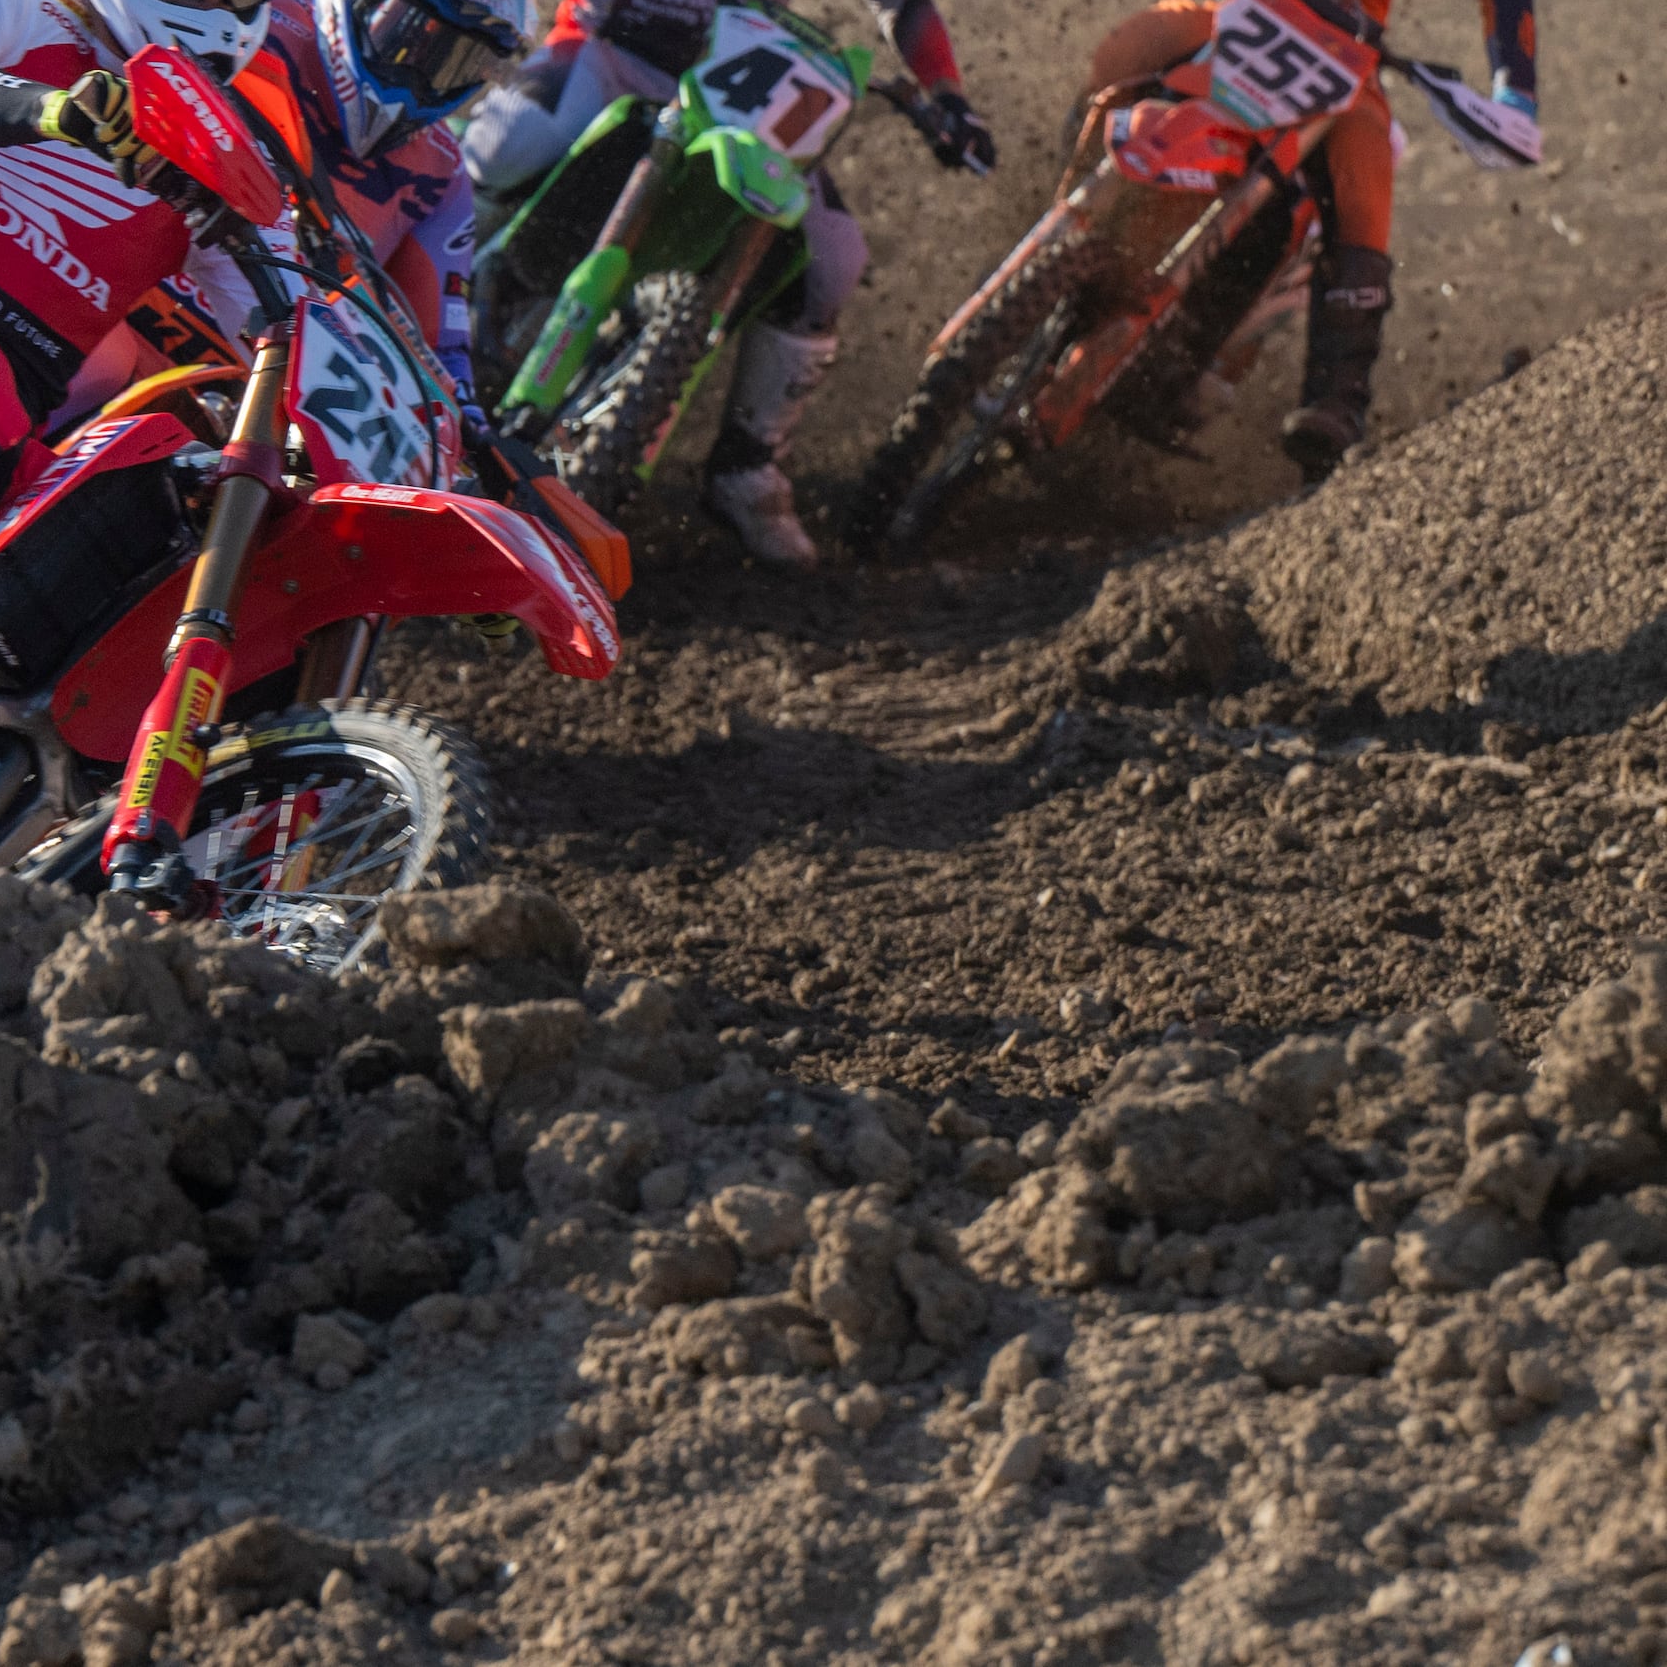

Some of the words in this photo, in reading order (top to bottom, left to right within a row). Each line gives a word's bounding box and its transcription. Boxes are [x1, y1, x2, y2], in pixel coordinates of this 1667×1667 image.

[703, 46, 835, 151] 41
[1215, 7, 1353, 117] 253
[2, 310, 64, 359] FUTURE
